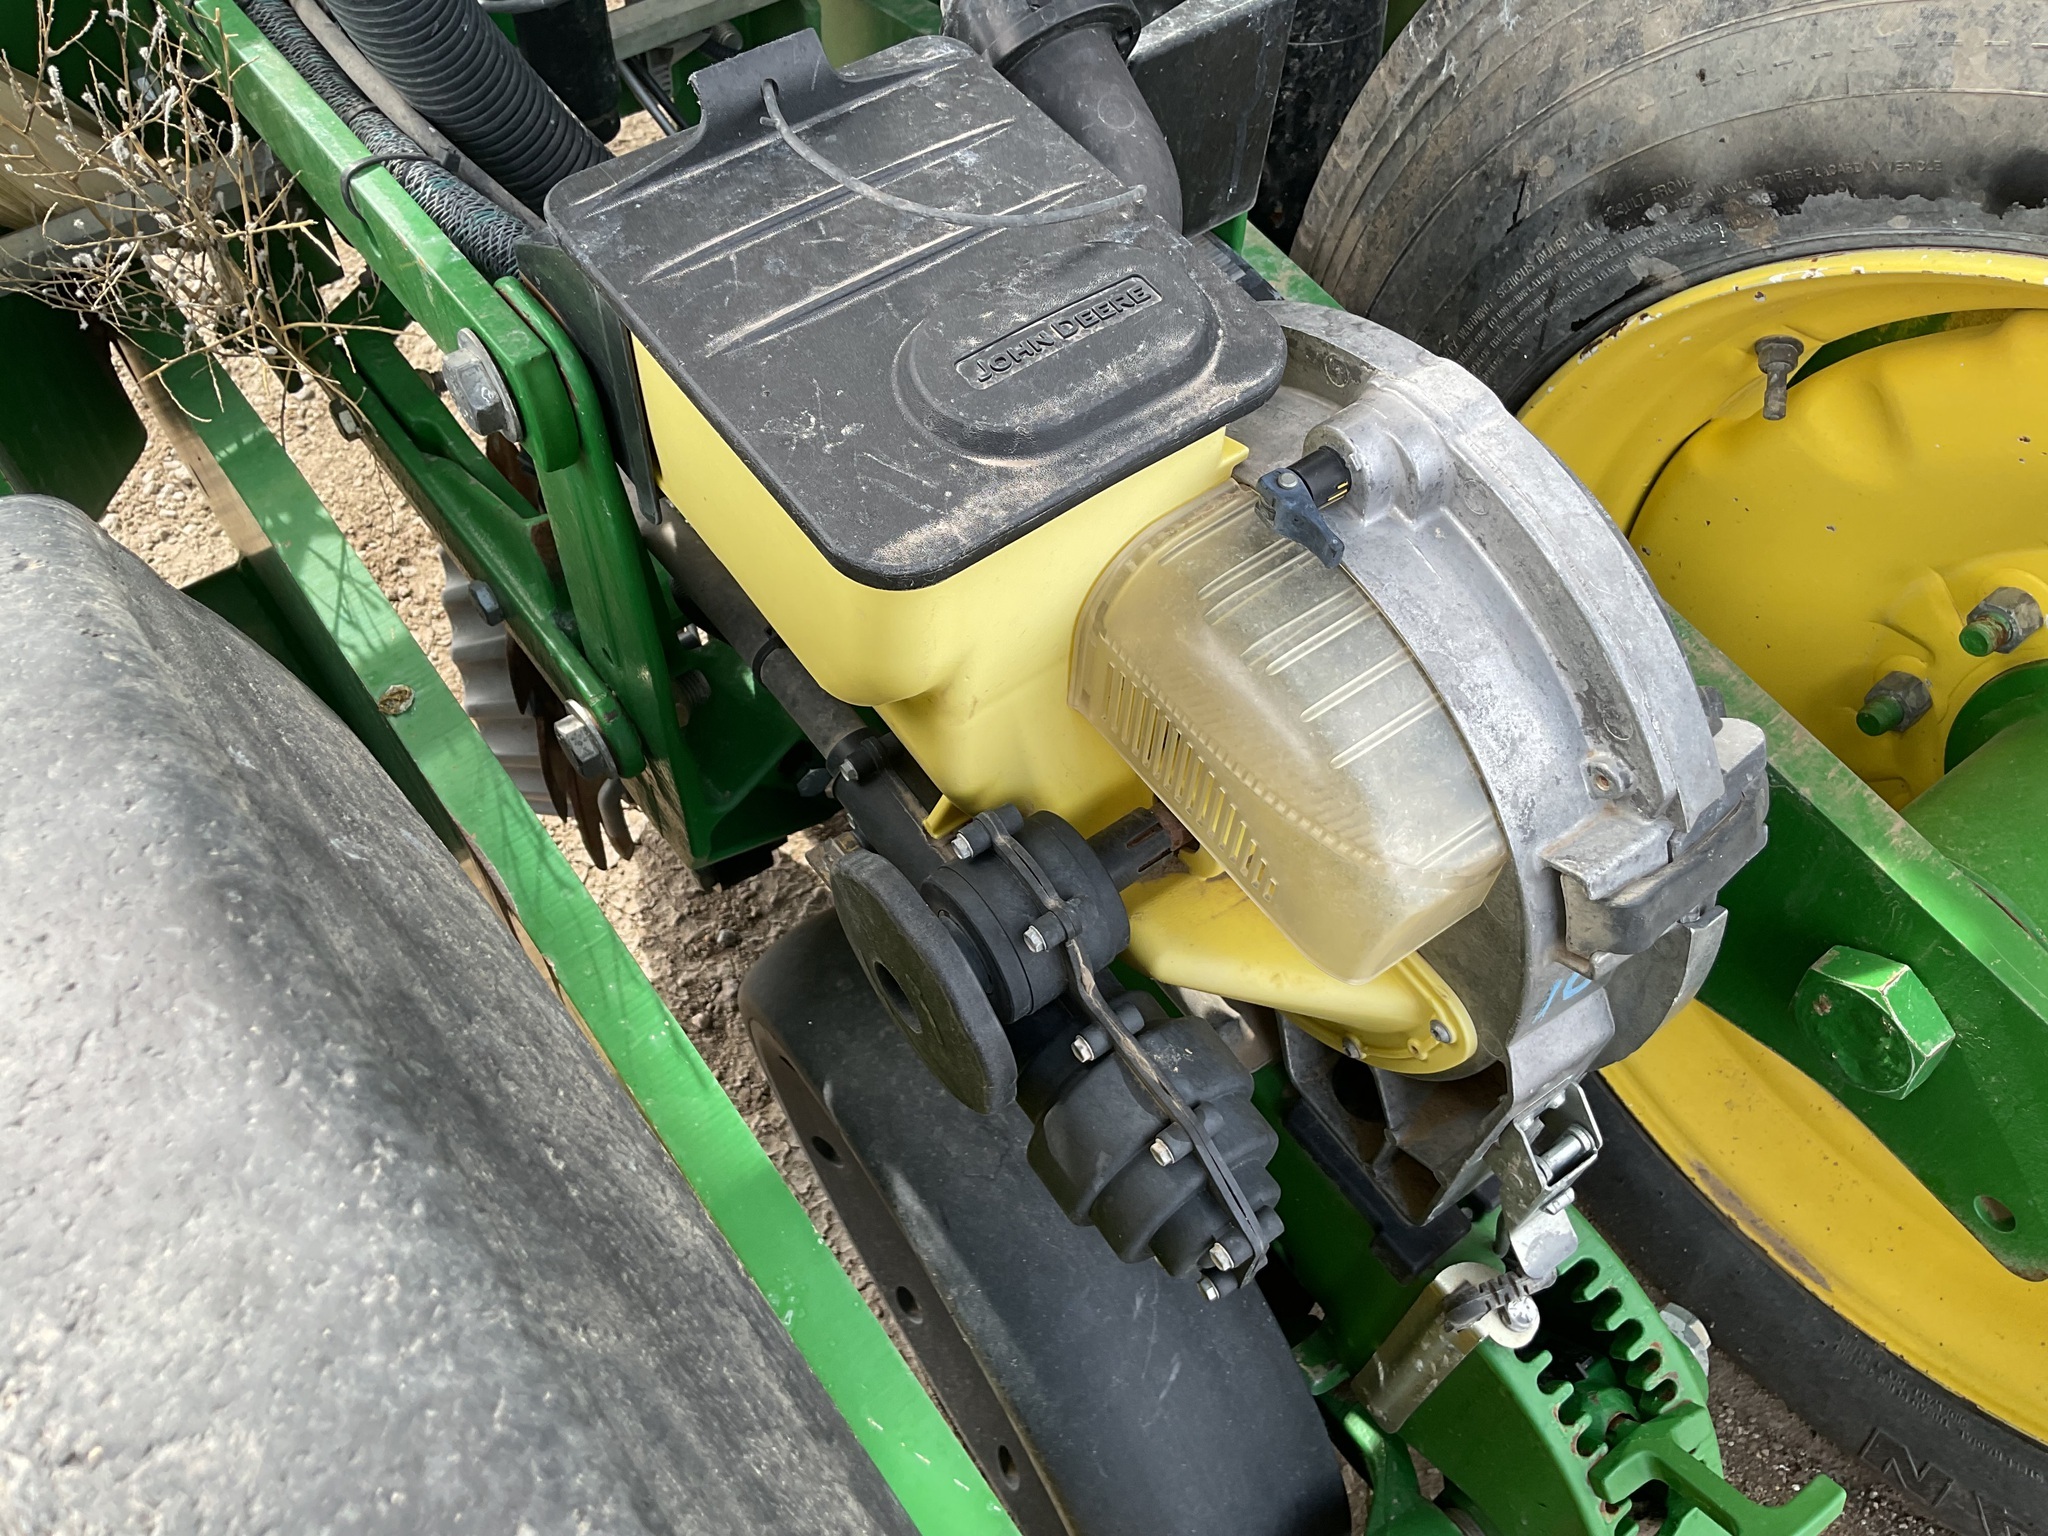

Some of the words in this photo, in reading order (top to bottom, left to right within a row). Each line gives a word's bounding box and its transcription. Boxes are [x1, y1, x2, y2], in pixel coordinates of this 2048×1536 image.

[1753, 173, 1772, 187] OR
[1774, 167, 1803, 182] TIRE
[1804, 160, 1863, 177] PLACARD
[1577, 242, 1622, 274] IMPROPER
[1493, 259, 1537, 299] SERIOUS
[977, 329, 1054, 382] JOHN
[1051, 286, 1151, 339] DEERE
